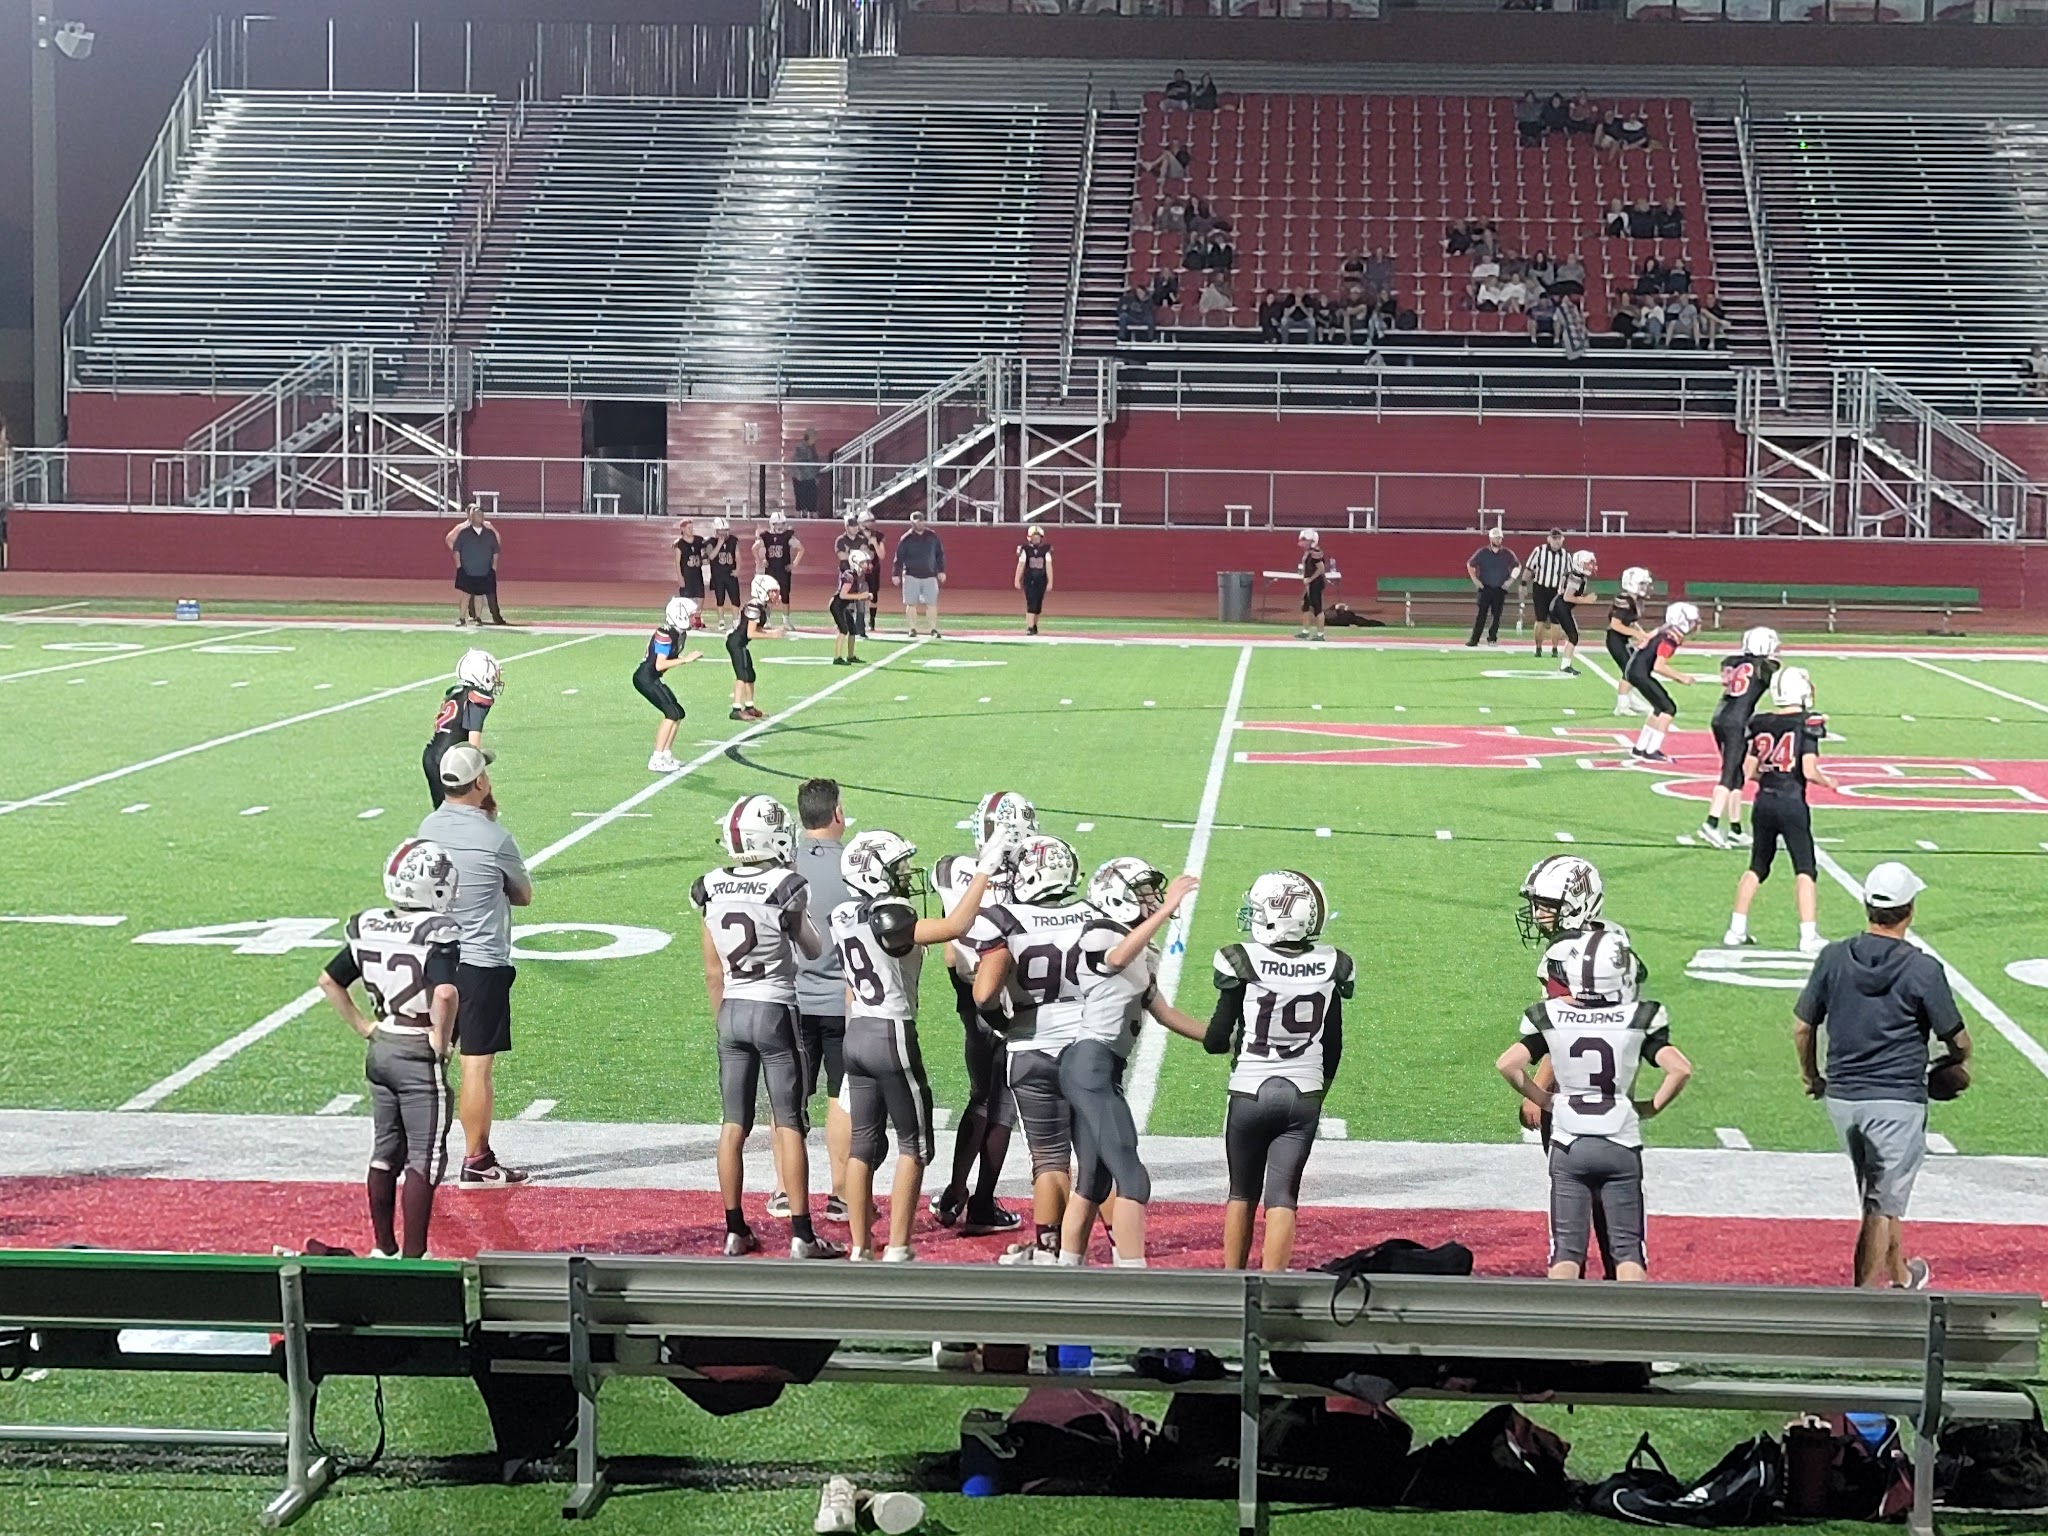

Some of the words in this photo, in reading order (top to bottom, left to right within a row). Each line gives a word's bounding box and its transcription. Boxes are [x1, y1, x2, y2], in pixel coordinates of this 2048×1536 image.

[1754, 732, 1796, 773] 24
[713, 881, 768, 896] TROJANS
[1033, 911, 1093, 927] TROJANS
[721, 912, 766, 980] 2
[357, 949, 434, 1028] 52
[1260, 960, 1327, 978] TROJANS
[1247, 991, 1326, 1059] 19
[1557, 1010, 1625, 1025] TROJANS
[1568, 1036, 1617, 1115] 3
